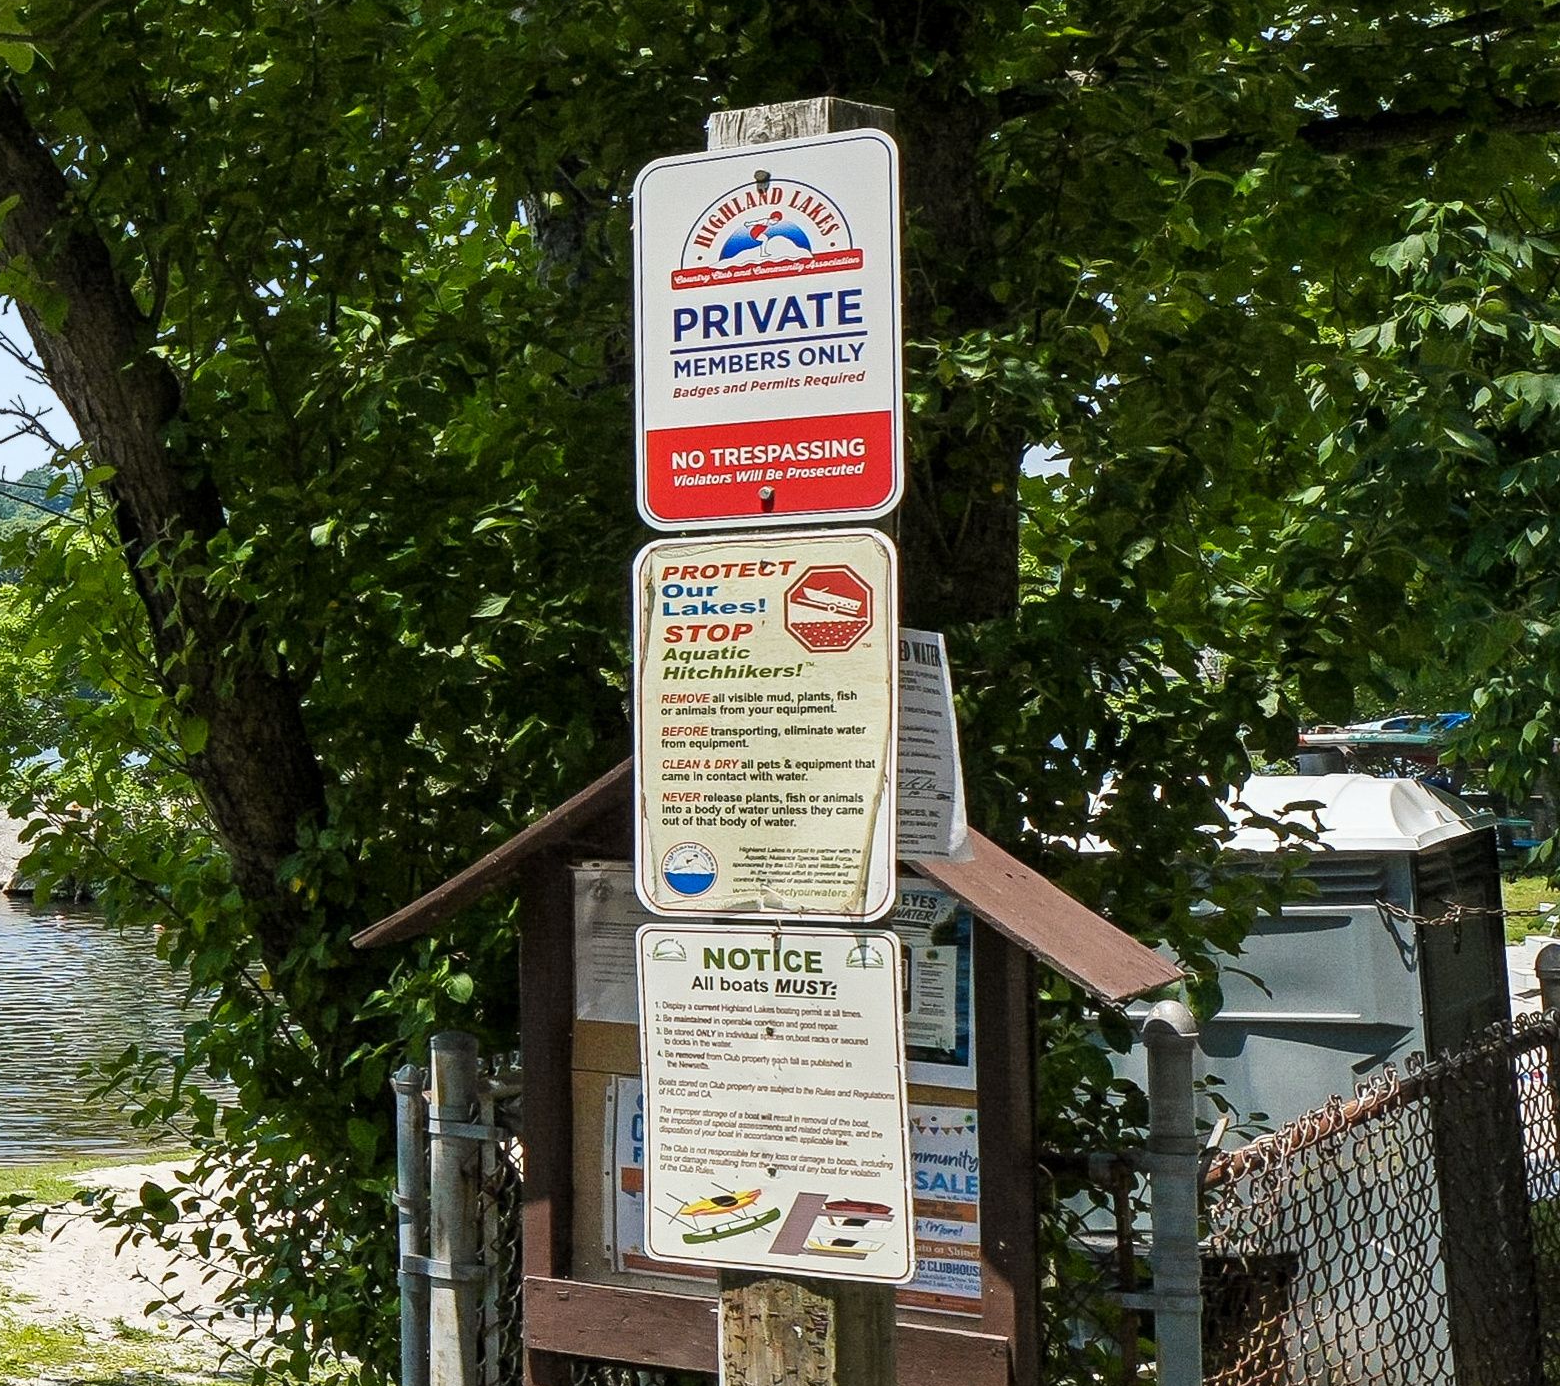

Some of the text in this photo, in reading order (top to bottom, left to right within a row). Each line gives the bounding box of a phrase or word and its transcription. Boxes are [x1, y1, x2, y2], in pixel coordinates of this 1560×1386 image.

[694, 188, 840, 249] HIGHLAND LAKES
[674, 256, 859, 284] Country Club and Community Association
[674, 290, 862, 342] PRIVATE
[674, 342, 864, 378] MEMBERS ONLY
[673, 371, 865, 398] Badges and Permits Required
[672, 439, 865, 469] NO TRESPASSING
[674, 462, 865, 486] Violators Will Be Prosecuted
[662, 560, 796, 581] PROTECT
[662, 584, 718, 598] Our
[663, 599, 765, 616] Lakes!
[664, 624, 753, 643] STOP
[663, 646, 750, 664] Aquatic
[662, 691, 857, 704] REMOVE all visible mud, plants, fish
[676, 706, 716, 715] animals
[720, 705, 745, 714] from
[749, 707, 774, 716] your
[777, 704, 837, 716] equipment.
[662, 725, 866, 738] BEFORE transporting, eliminate water
[662, 739, 749, 750] from equipment.
[663, 759, 875, 771] CLEAN & DRY all pets & equipment that
[694, 772, 703, 781] in
[707, 772, 746, 781] contact
[750, 771, 773, 781] with
[776, 772, 808, 781] water.
[663, 793, 701, 802] NEVER
[704, 793, 742, 802] release
[746, 793, 782, 805] plants,
[786, 793, 806, 802] fish
[823, 793, 863, 802] animals
[663, 805, 682, 813] into
[695, 805, 721, 817] body
[725, 805, 736, 814] of
[739, 806, 769, 814] water
[772, 805, 807, 815] unless
[811, 806, 833, 817] they
[662, 817, 796, 828] out of that body of water.
[902, 894, 937, 909] EYES
[704, 948, 823, 973] NOTICE
[692, 976, 837, 995] All boats MUST:
[662, 1001, 686, 1011] Display
[721, 1004, 752, 1013] Highland
[754, 1005, 775, 1013] Lakes
[663, 1014, 672, 1022] Be
[674, 1016, 712, 1024] maintained
[722, 1018, 752, 1026] operable
[800, 1022, 816, 1030] good
[915, 1171, 978, 1194] SALE
[927, 1261, 980, 1277] CLUBHOUS
